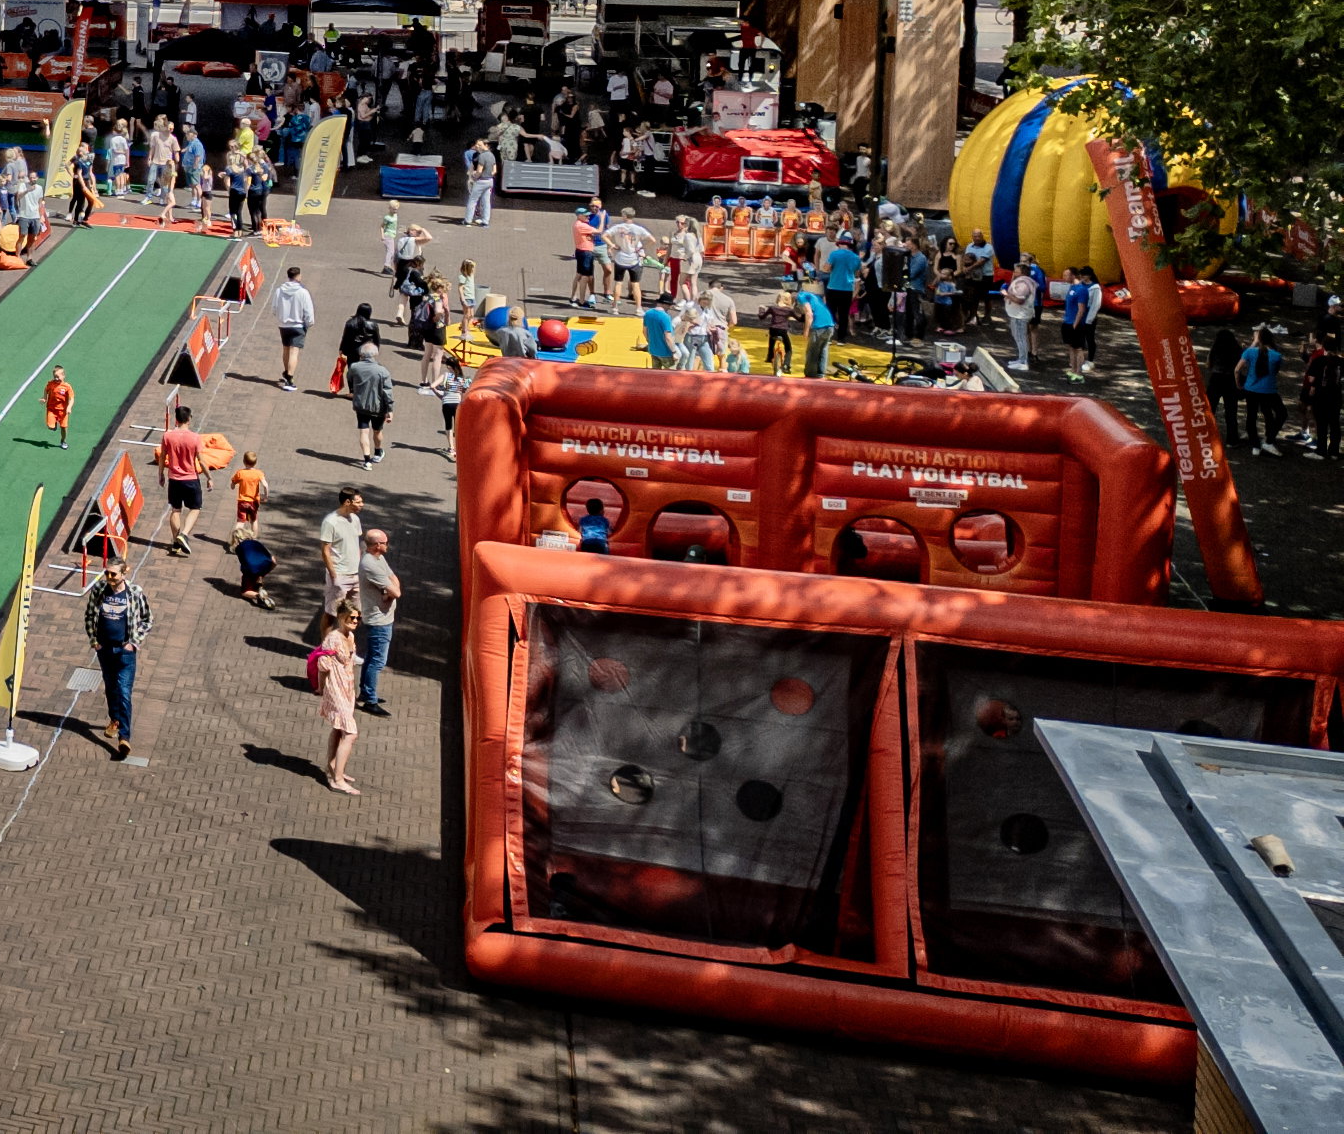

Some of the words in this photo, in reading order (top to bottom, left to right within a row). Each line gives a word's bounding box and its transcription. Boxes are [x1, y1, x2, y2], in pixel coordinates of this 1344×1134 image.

[1178, 335, 1207, 428] Experience
[572, 424, 632, 442] WATCH
[635, 429, 698, 447] ACTION
[1162, 391, 1195, 484] TeamNL
[562, 438, 611, 456] PLAY
[615, 442, 725, 465] VOLLEYBAL
[863, 446, 928, 465] WATCH
[931, 452, 1000, 469] ACTION
[1196, 432, 1219, 480] Sport
[852, 461, 906, 480] PLAY
[910, 467, 1029, 490] VOLLEYBAL
